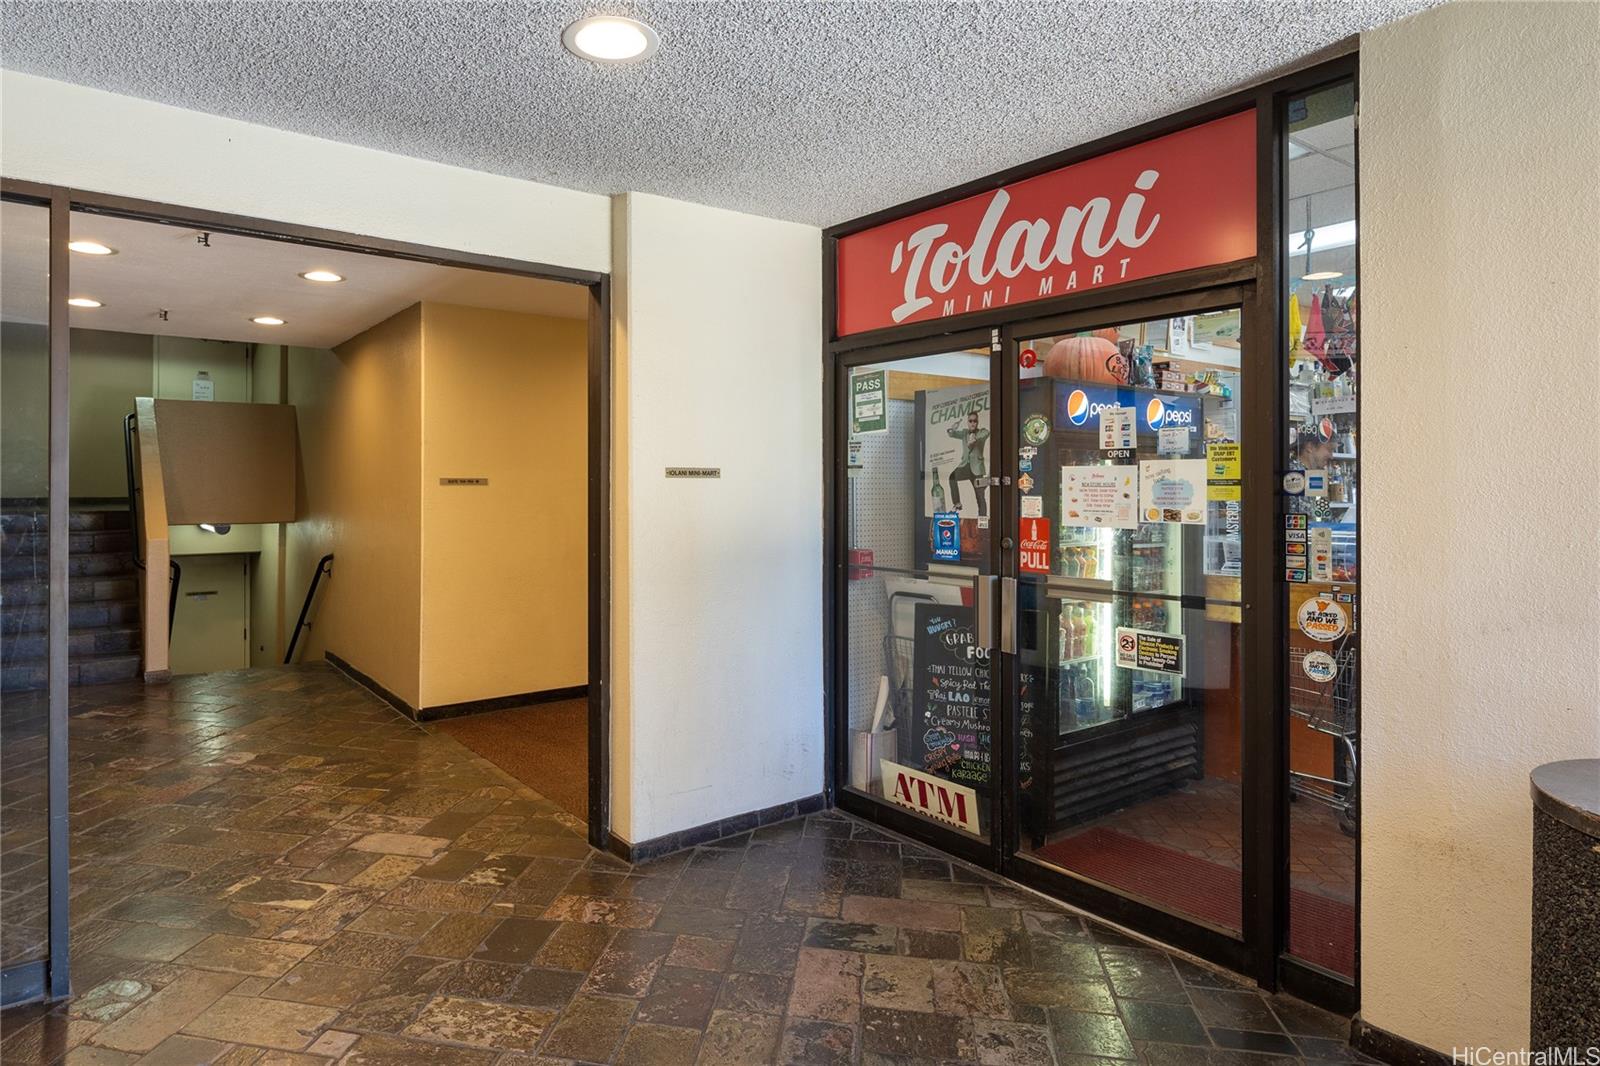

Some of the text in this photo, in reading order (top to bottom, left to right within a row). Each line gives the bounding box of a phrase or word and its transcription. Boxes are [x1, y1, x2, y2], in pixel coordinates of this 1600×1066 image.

[943, 258, 1130, 317] MINI MART
[856, 379, 881, 392] PASS
[1165, 410, 1192, 424] pepsi
[1107, 450, 1130, 458] OPEN
[1020, 551, 1049, 570] PULL
[1306, 615, 1323, 623] AND
[1306, 622, 1339, 631] PASSED
[946, 632, 975, 646] GRAB
[948, 665, 972, 676] YELLOW
[948, 691, 970, 702] LAO
[982, 708, 991, 720] S
[930, 716, 961, 729] Creamy
[893, 772, 968, 824] ATM
